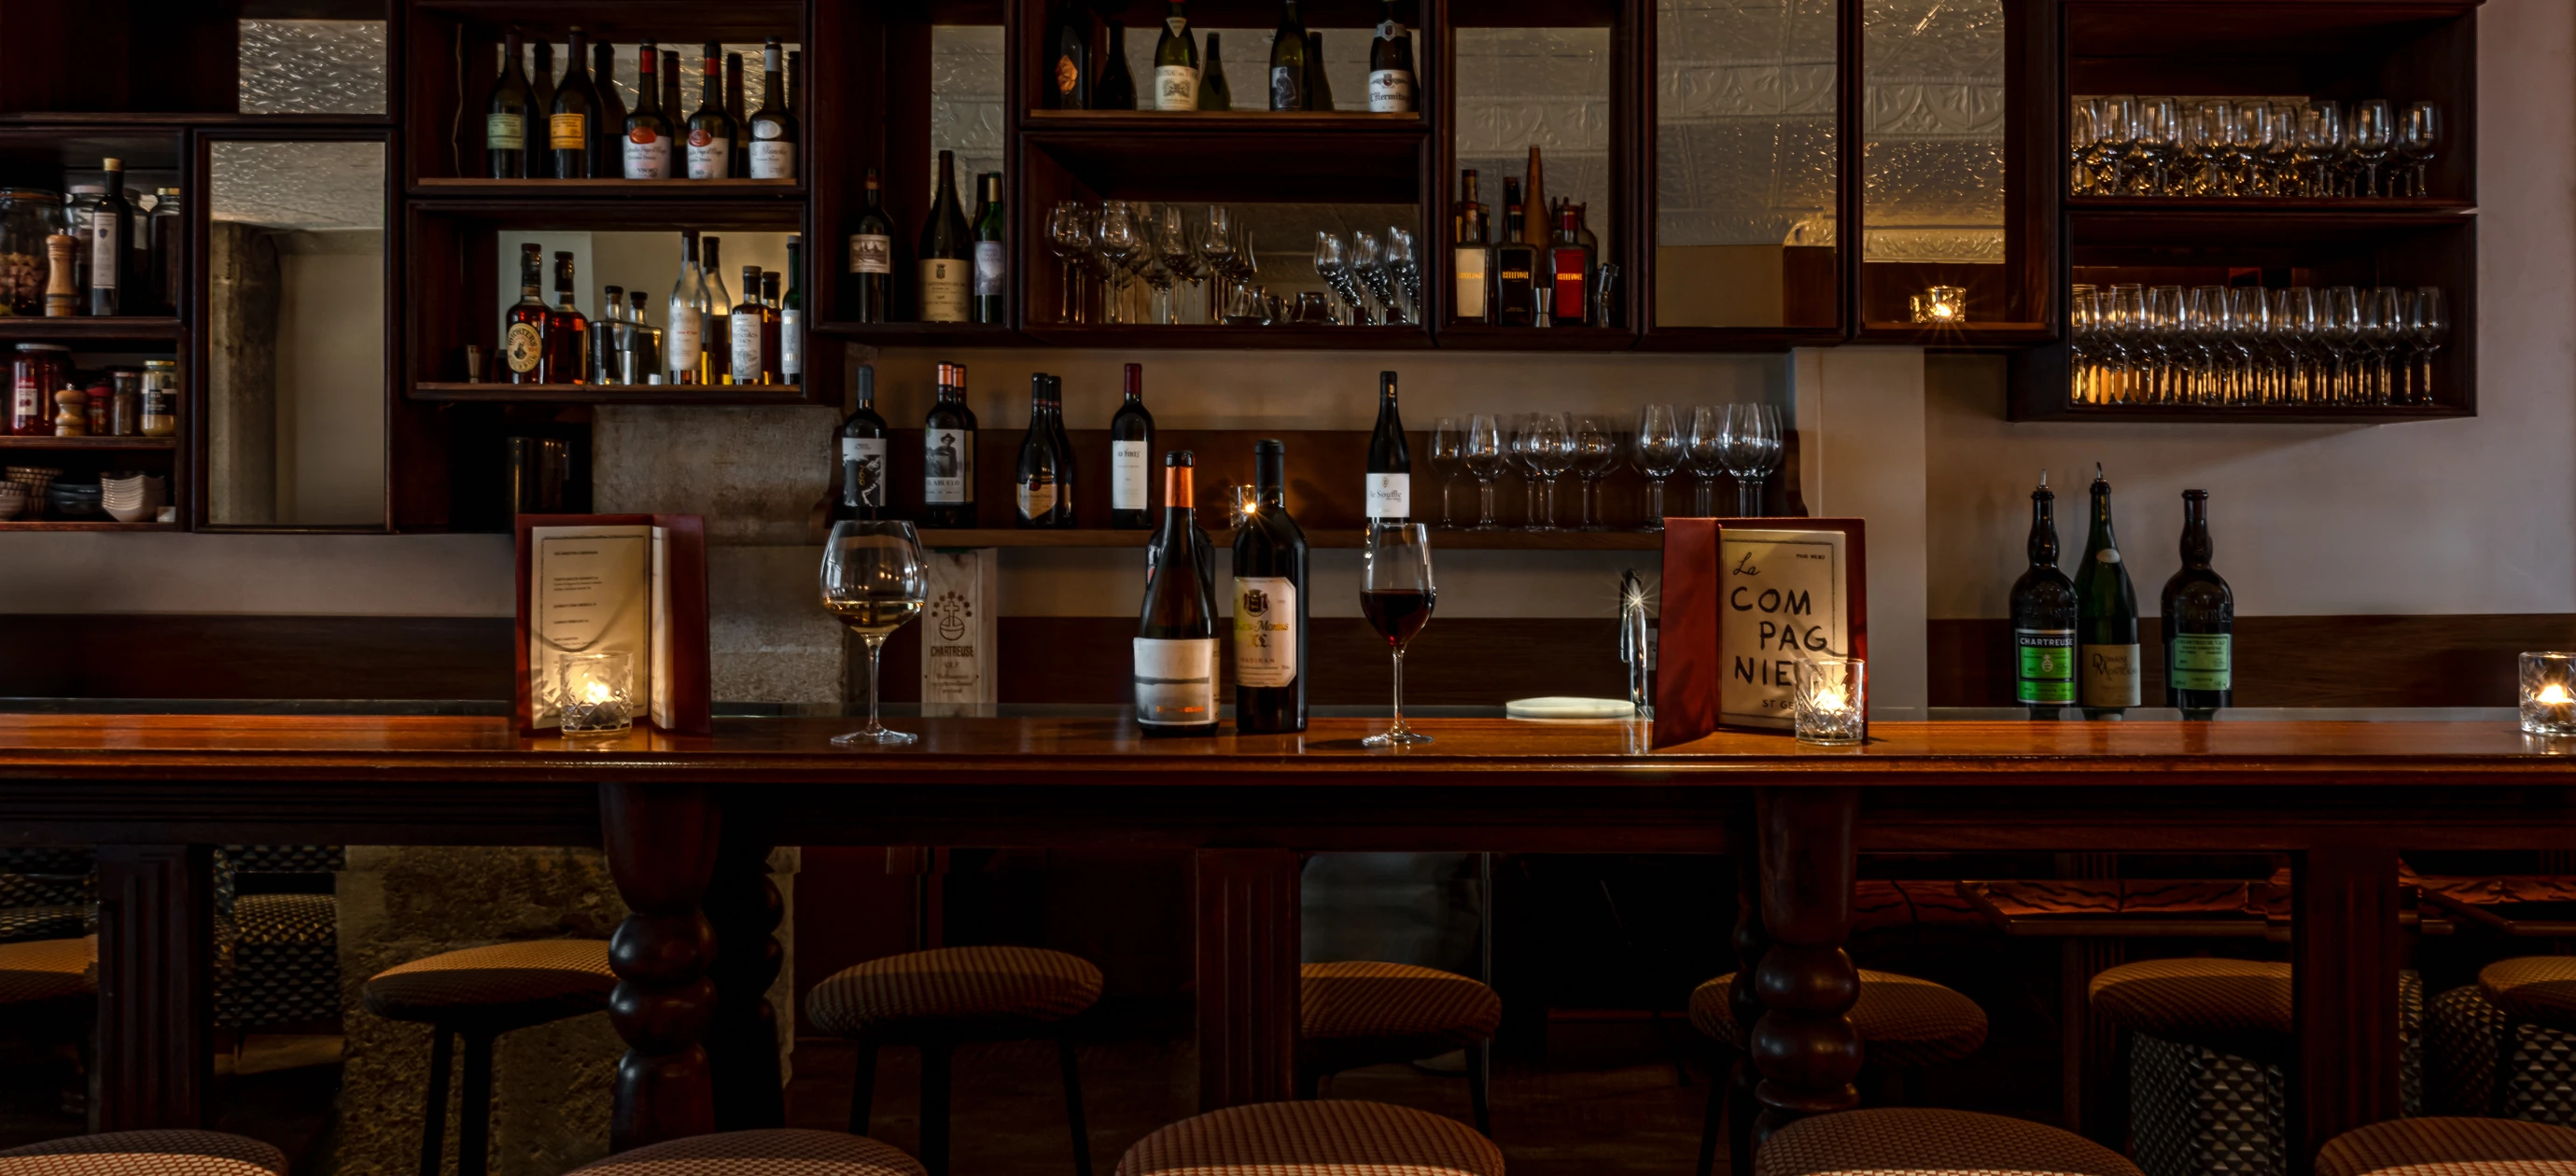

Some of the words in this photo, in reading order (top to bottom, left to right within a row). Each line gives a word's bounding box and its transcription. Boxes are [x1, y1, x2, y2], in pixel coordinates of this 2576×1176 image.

[1732, 552, 1761, 576] La
[1730, 586, 1812, 616] COM
[1759, 621, 1828, 651] PAG
[2020, 637, 2074, 647] CHARTREUSE
[931, 645, 974, 657] CHARTREUSE
[1735, 655, 1794, 688] NIE
[1762, 699, 1776, 709] ST
